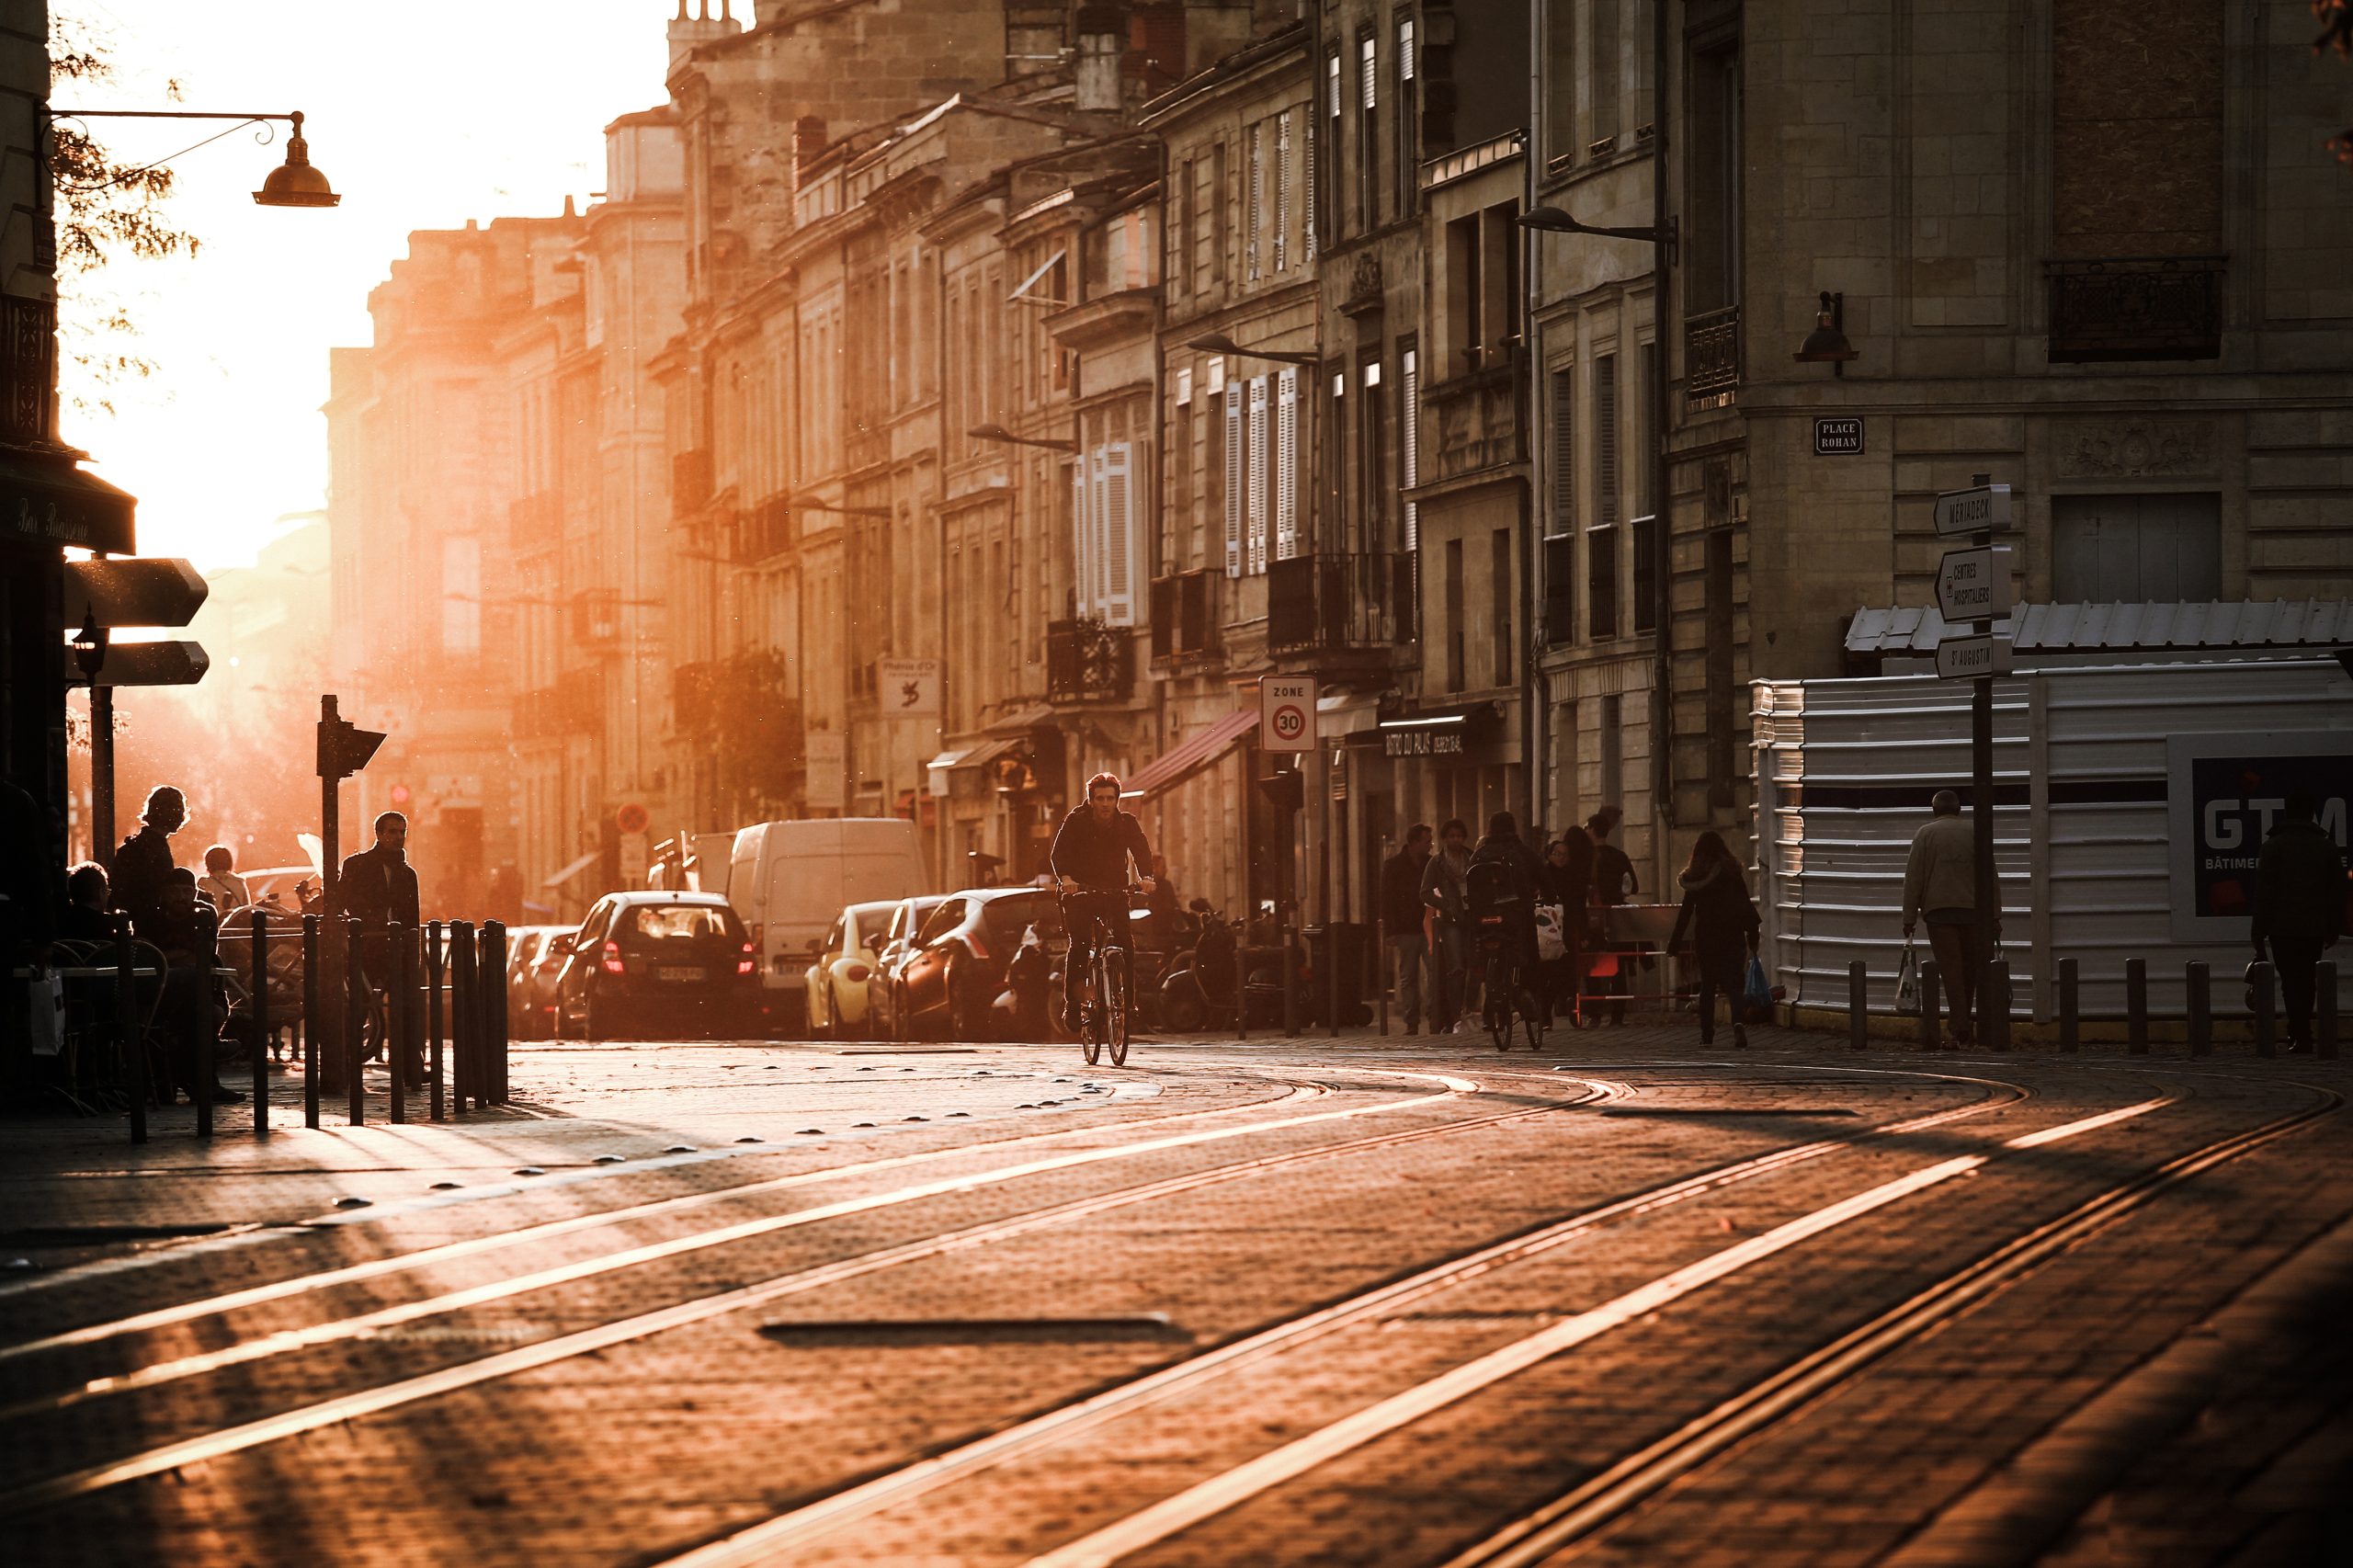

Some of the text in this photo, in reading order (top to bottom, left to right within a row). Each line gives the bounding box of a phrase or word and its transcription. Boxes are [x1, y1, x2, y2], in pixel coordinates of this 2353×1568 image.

[1823, 424, 1856, 434] PLACE
[1822, 437, 1857, 448] ROHAN
[17, 497, 89, 542] Bar Brasserie
[1949, 497, 1990, 525] MÉRIADECK
[1953, 562, 1977, 581] CENTRES
[1953, 586, 1990, 607] HOSPITALIERS
[1960, 646, 1991, 665] AUGUSTIN
[1273, 687, 1304, 698] ZONE
[1279, 715, 1300, 731] 30
